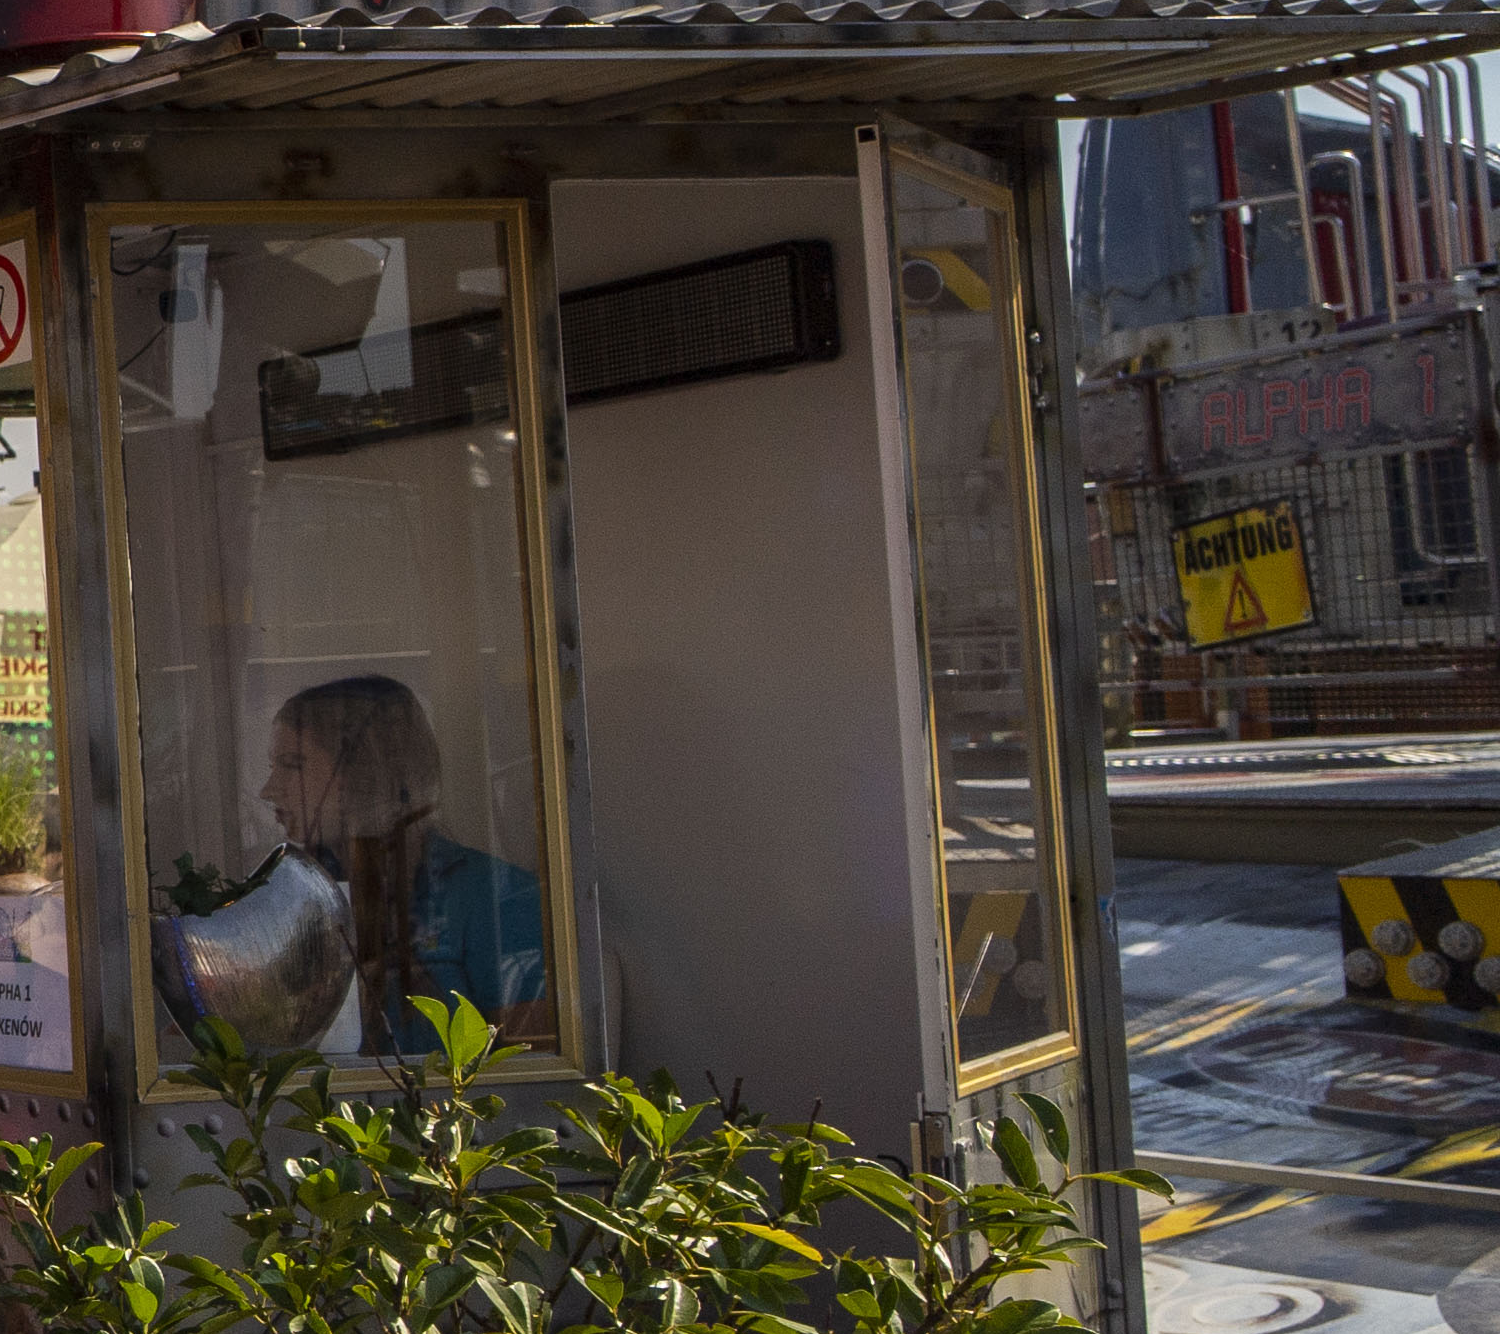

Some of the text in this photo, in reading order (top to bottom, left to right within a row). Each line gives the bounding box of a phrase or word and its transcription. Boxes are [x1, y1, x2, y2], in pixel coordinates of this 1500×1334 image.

[1203, 354, 1435, 450] ALPHA 1
[1184, 516, 1294, 575] ACHTUNG
[25, 984, 32, 1001] 1
